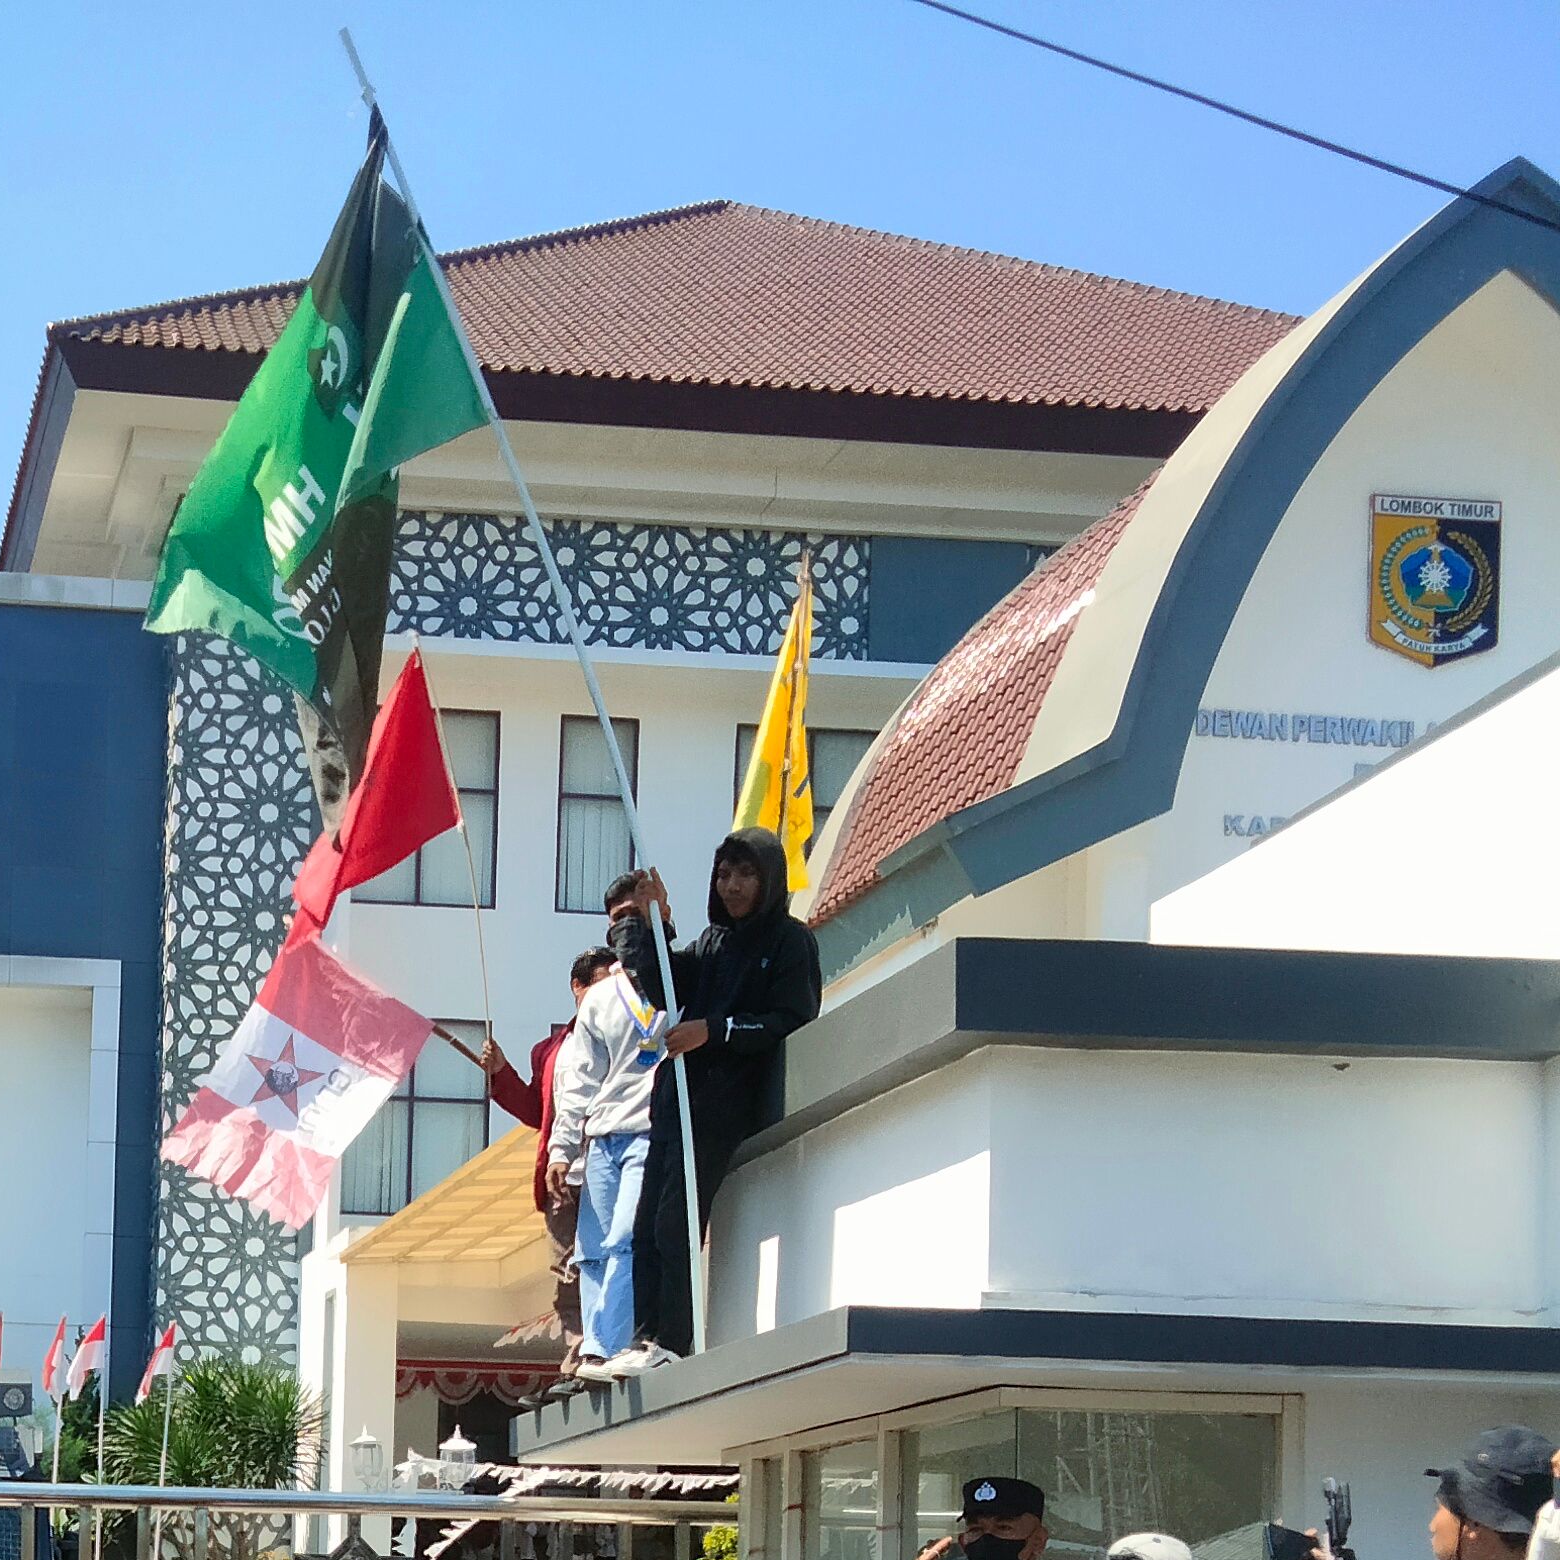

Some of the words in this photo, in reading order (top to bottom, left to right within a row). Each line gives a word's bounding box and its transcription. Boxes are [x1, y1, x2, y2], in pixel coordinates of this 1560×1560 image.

[1380, 498, 1445, 517] LOMBOK
[1449, 502, 1495, 519] TIMUR
[1195, 708, 1288, 741] DEWAN
